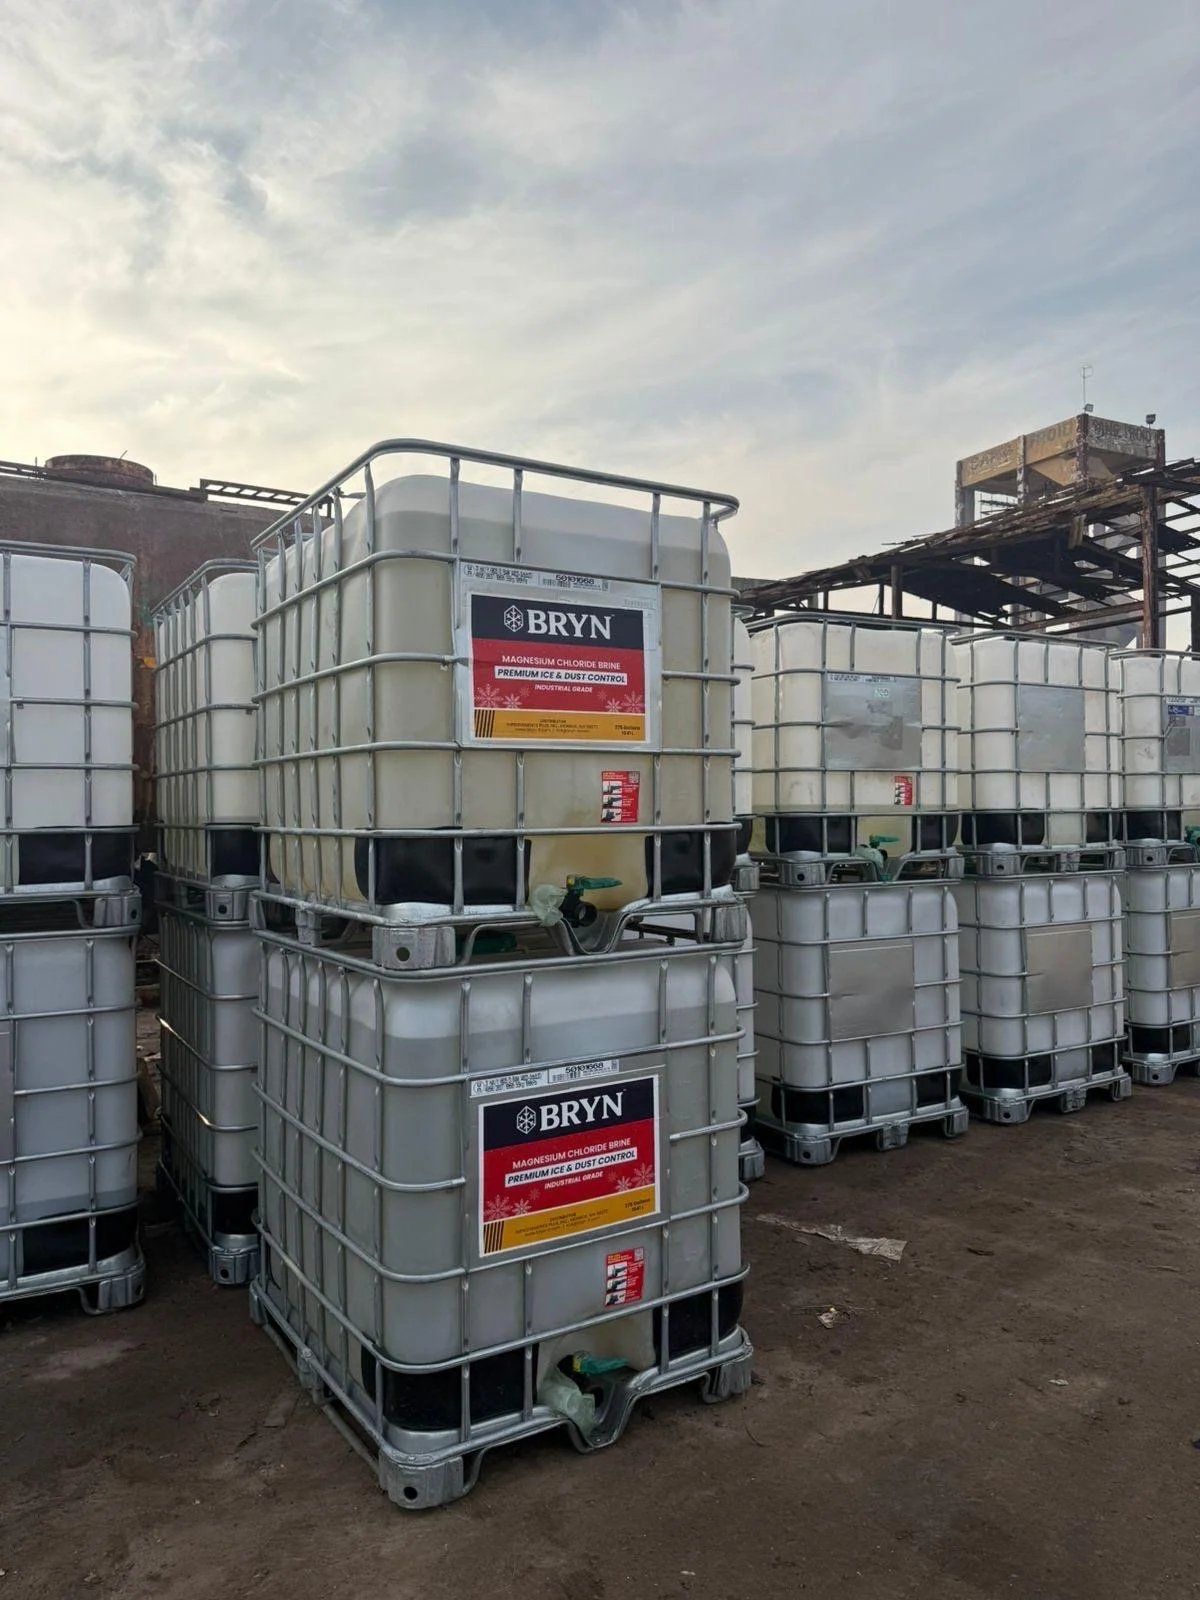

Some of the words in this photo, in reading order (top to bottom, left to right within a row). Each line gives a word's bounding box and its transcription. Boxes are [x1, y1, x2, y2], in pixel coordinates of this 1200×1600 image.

[527, 609, 612, 640] BRYN
[497, 669, 539, 678] PREMIUM
[540, 671, 554, 679] ICE
[556, 672, 562, 680] &
[564, 672, 587, 680] DUST
[588, 674, 625, 683] CONTROL
[502, 655, 555, 665] MAGNESIUM
[557, 659, 597, 669] CHLORIDE
[598, 662, 621, 670] BRINE
[540, 1092, 623, 1132] BRYN
[507, 1169, 549, 1184] PREMIUM
[550, 1166, 564, 1176] ICE
[566, 1164, 573, 1172] &
[574, 1160, 596, 1170] DUST
[597, 1150, 636, 1164] CONTROL
[512, 1151, 566, 1169] MAGNESIUM
[567, 1143, 607, 1158] CHLORIDE
[608, 1138, 631, 1150] BRINE
[544, 1176, 581, 1189] INDUSTRIAL
[582, 1171, 604, 1181] GRADE
